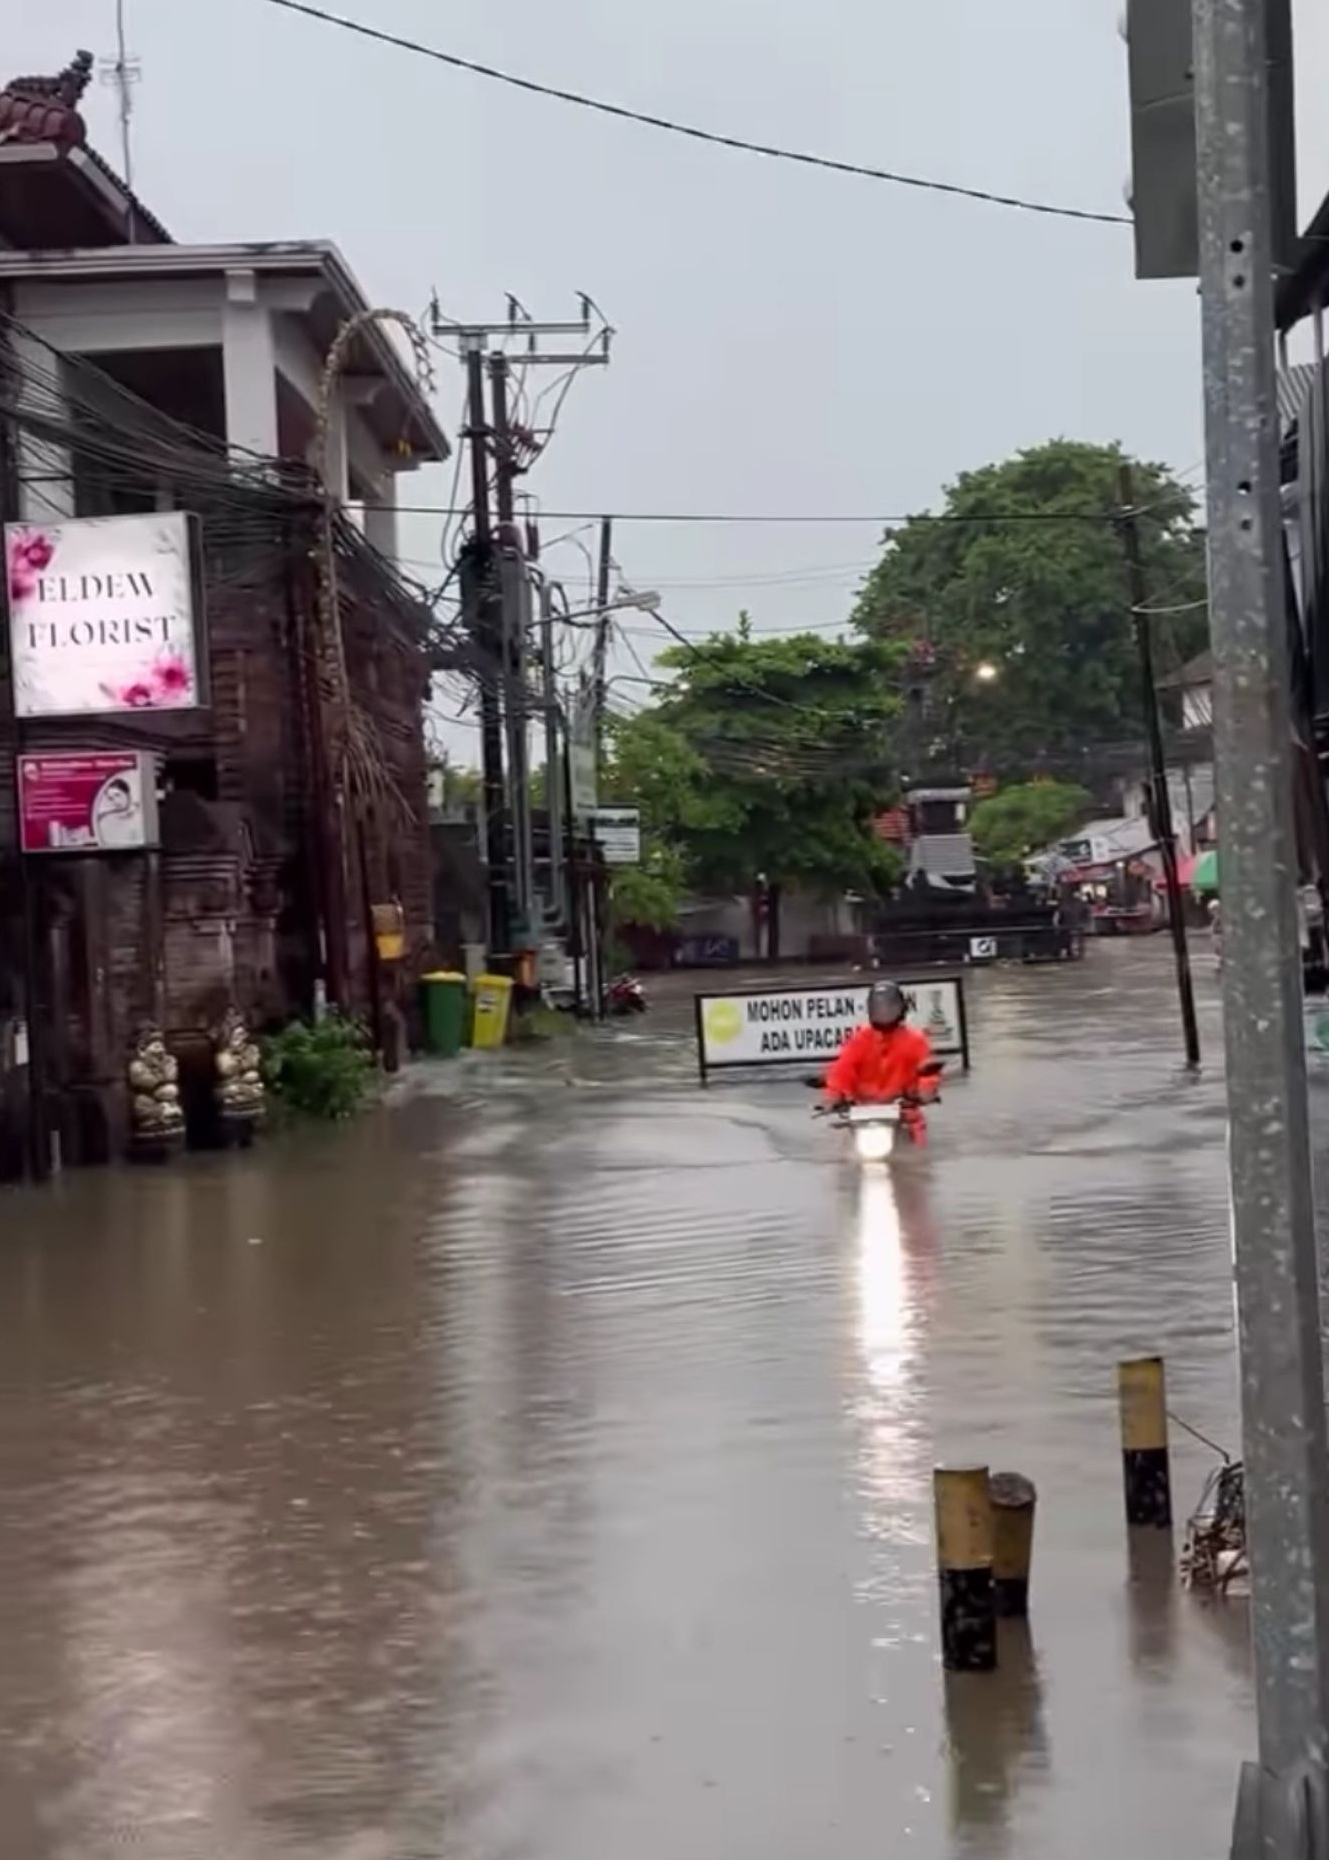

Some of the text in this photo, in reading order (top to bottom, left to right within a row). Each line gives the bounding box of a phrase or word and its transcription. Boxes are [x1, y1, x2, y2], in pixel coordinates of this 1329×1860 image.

[39, 572, 154, 602] ELDEW
[29, 615, 177, 649] FLORIST
[748, 1000, 803, 1022] MOHON
[807, 997, 855, 1019] PELAN
[761, 1030, 791, 1052] ADA
